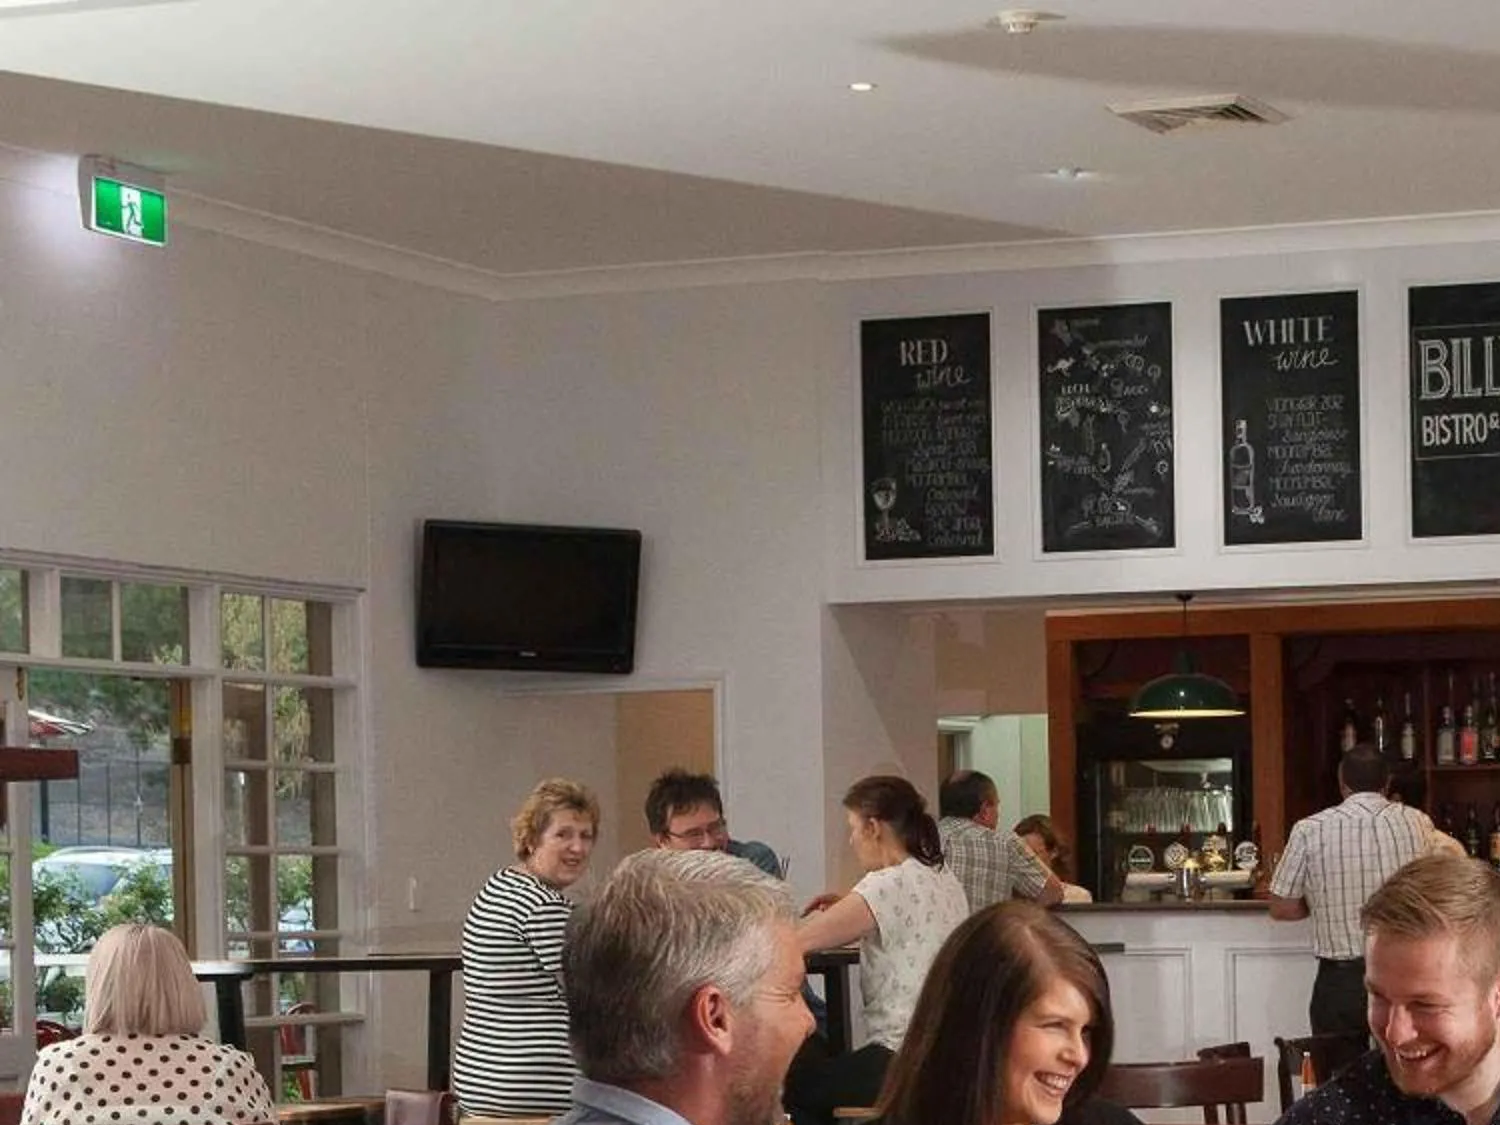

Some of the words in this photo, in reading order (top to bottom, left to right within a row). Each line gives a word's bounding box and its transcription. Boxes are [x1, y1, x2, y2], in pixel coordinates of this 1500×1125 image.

[1243, 315, 1334, 347] WHITE
[900, 339, 949, 366] RED
[1272, 346, 1339, 372] wine
